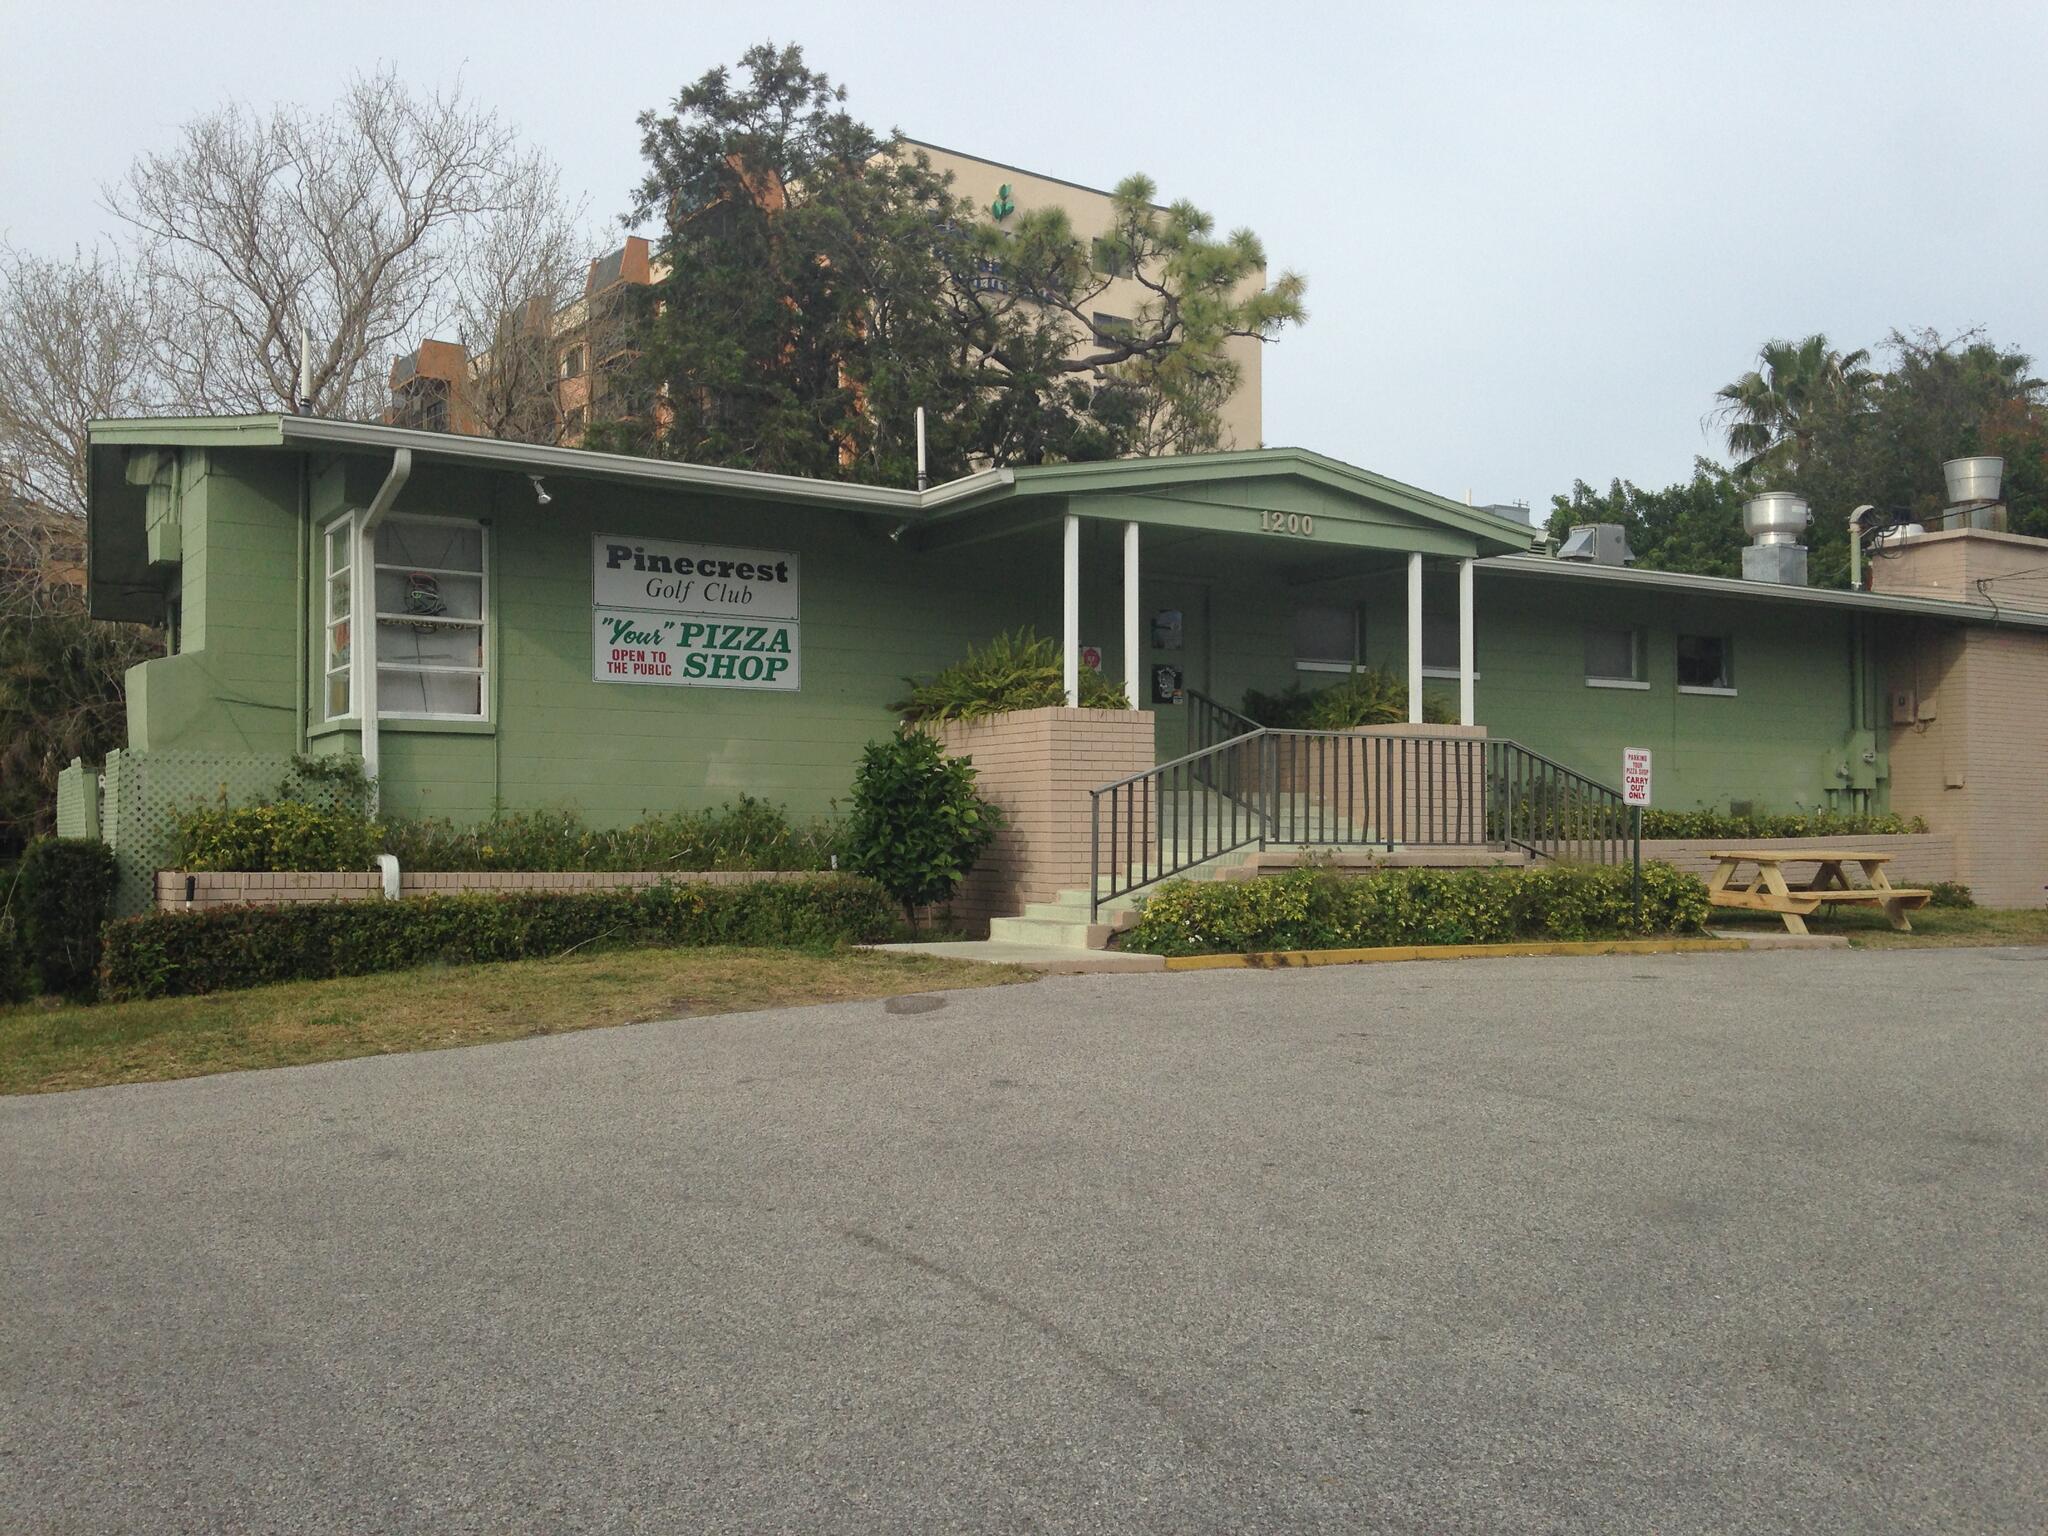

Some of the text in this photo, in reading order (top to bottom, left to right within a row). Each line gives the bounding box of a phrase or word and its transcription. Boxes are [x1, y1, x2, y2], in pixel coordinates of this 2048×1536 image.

[1260, 510, 1313, 535] 1200
[606, 544, 788, 583] Pinecrest
[646, 577, 753, 604] Golf Club
[602, 617, 791, 654] "Your" PIZZA
[607, 661, 672, 676] THE PUBLIC
[612, 648, 666, 663] OPEN TO
[682, 652, 789, 682] SHOP
[1626, 776, 1648, 784] CARRY
